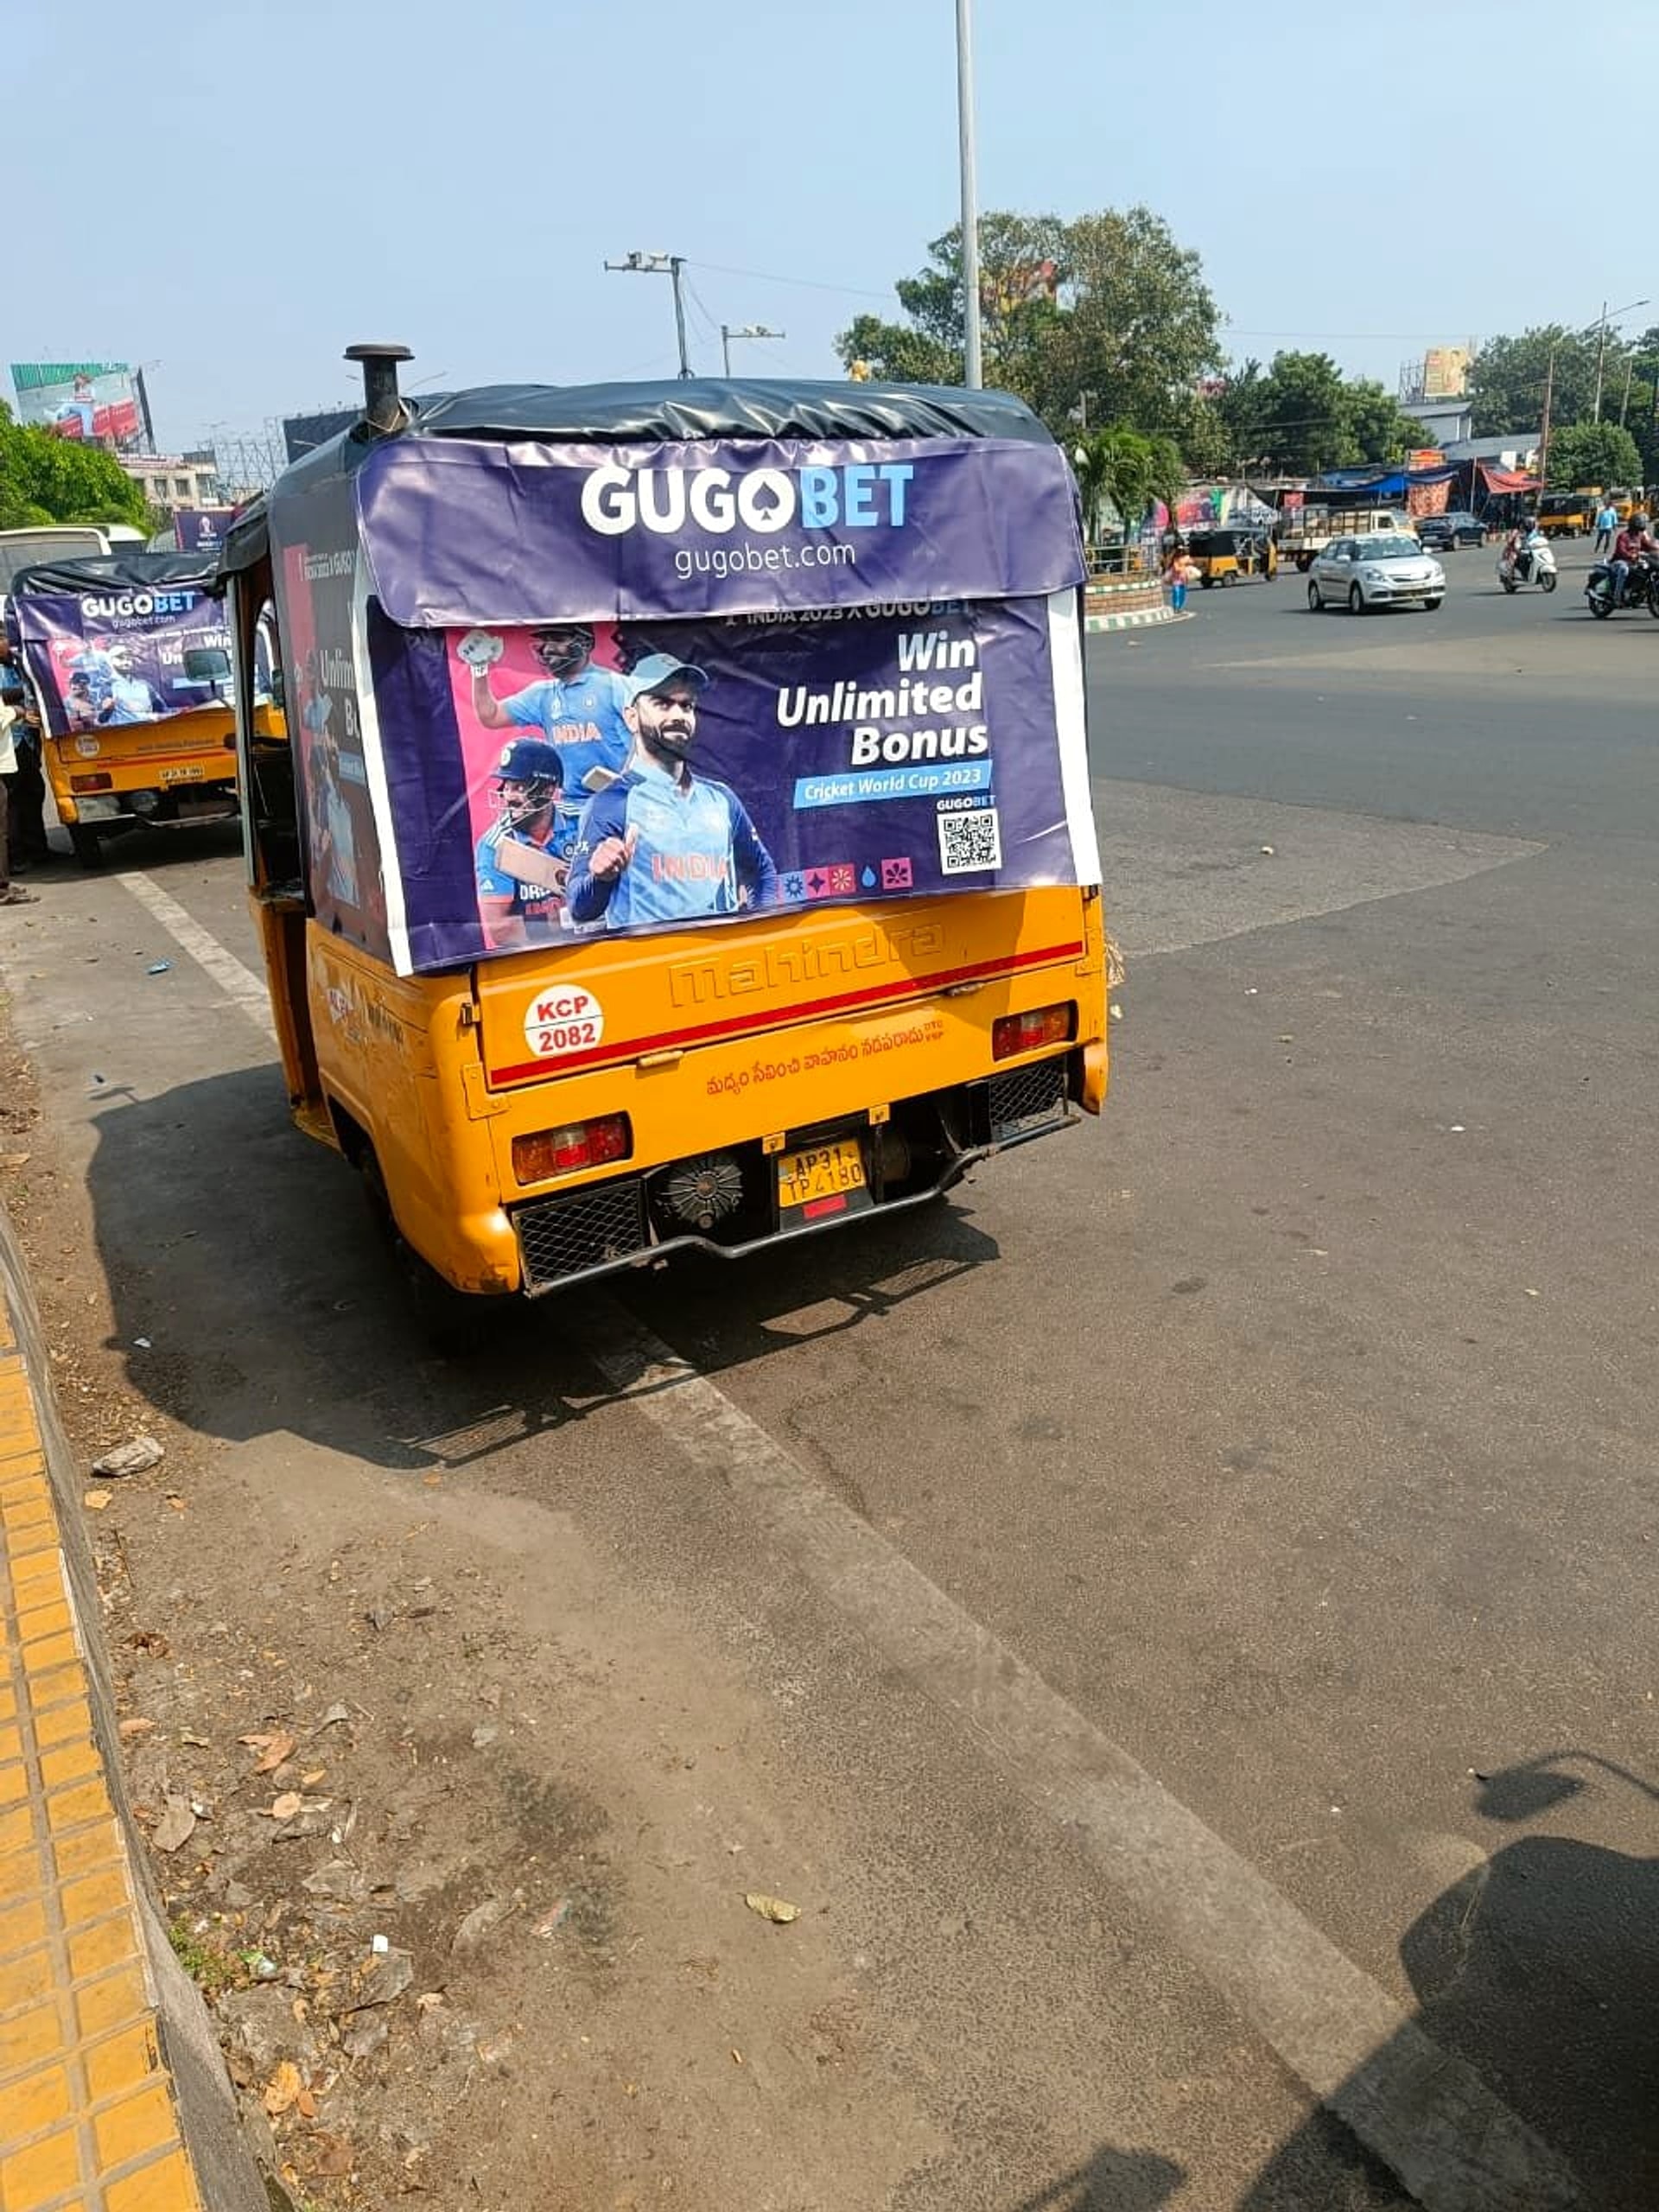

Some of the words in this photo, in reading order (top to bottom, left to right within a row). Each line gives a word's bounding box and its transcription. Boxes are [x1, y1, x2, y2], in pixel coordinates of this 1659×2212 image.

[581, 464, 913, 535] GUGOBET
[675, 543, 856, 580] gugobet.com
[82, 591, 195, 618] GUGOBET
[799, 607, 843, 621] 2023
[899, 631, 976, 671] Win
[777, 672, 983, 728] Unlimited
[553, 722, 601, 745] INDIA
[851, 725, 988, 765] Bonus
[804, 782, 854, 800] Cricket
[858, 777, 905, 794] World
[908, 774, 938, 791] Cup
[942, 768, 982, 786] 2023
[937, 795, 995, 810] GUGOBET
[652, 853, 729, 885] INDIA
[537, 995, 588, 1021] KCP
[539, 1022, 595, 1052] 2082
[707, 1071, 749, 1095] మద్యం
[804, 1043, 858, 1071] వాహనం
[795, 1147, 842, 1178] AP31
